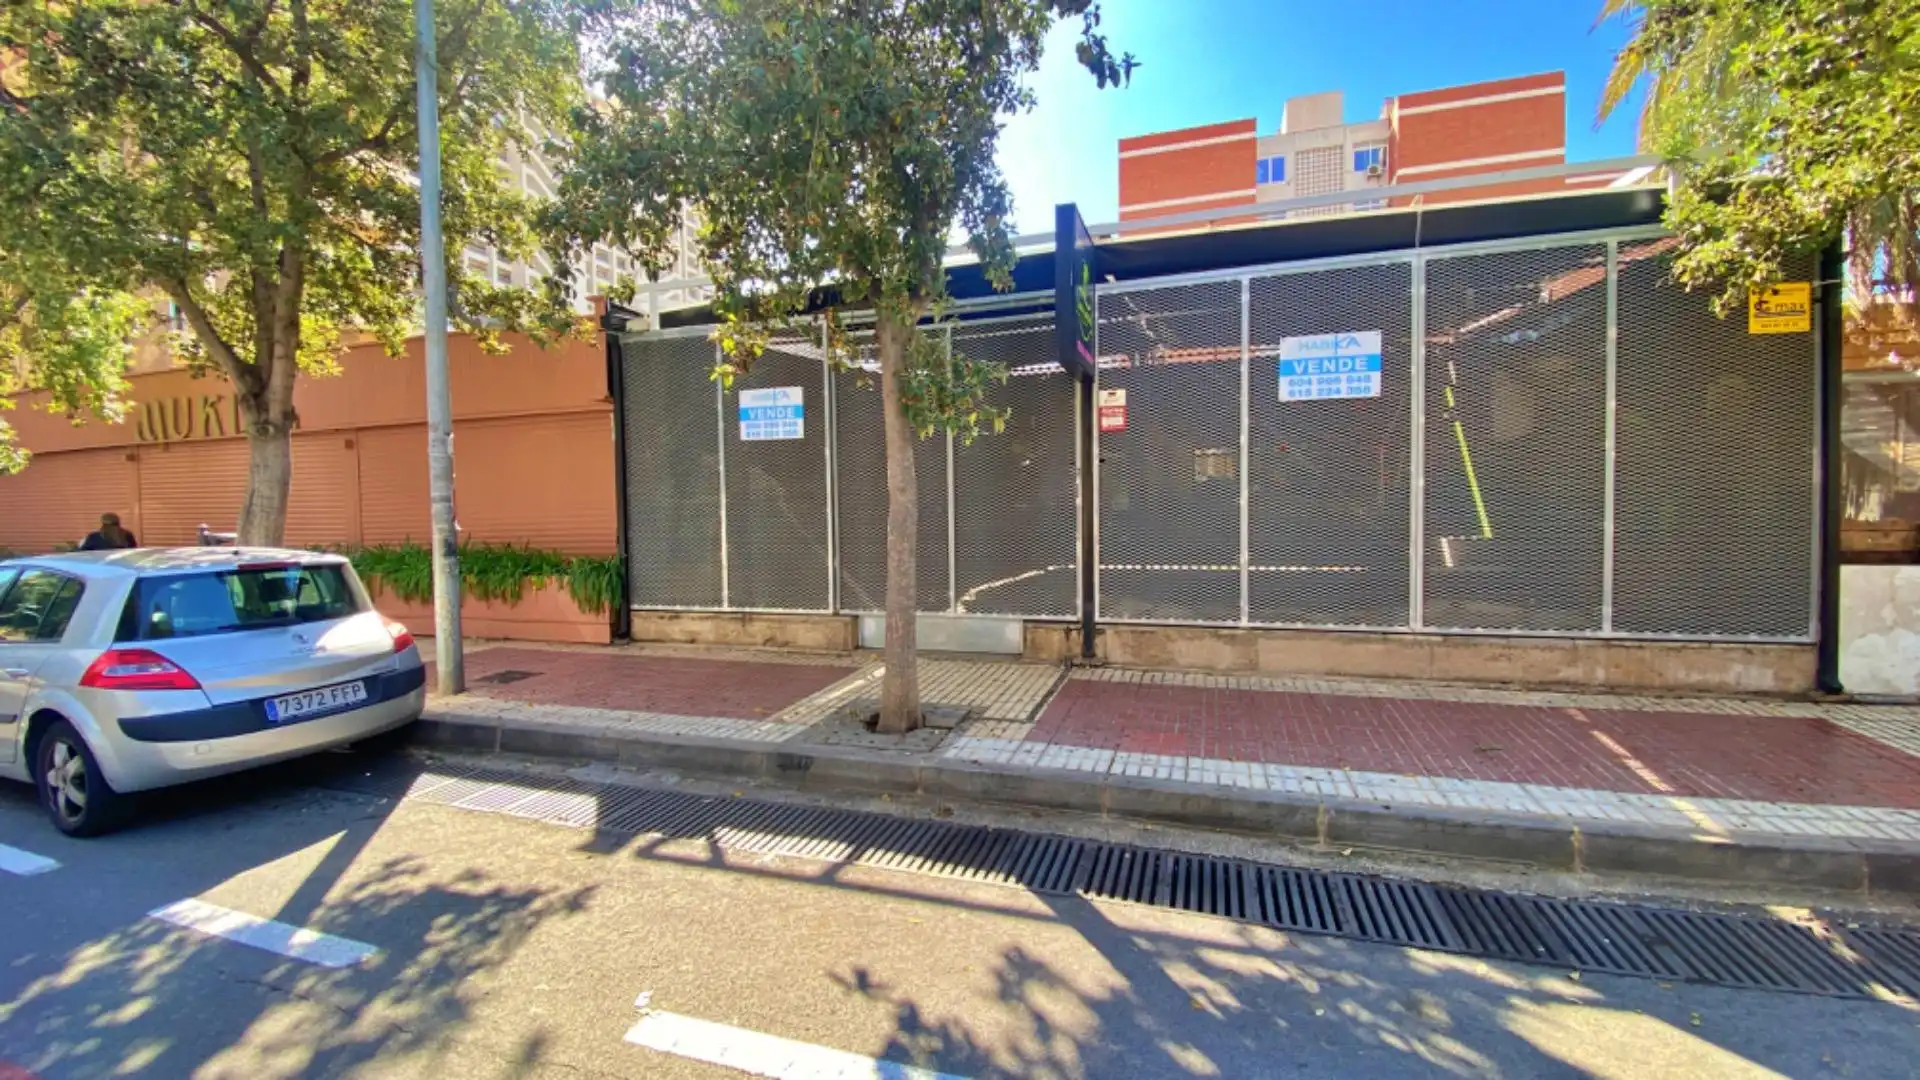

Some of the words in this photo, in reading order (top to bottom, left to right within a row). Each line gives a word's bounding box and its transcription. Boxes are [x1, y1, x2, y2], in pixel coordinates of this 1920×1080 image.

[1293, 357, 1369, 374] VENDE
[748, 406, 795, 420] VENDE
[279, 691, 327, 715] 7372
[331, 683, 361, 703] FFP
